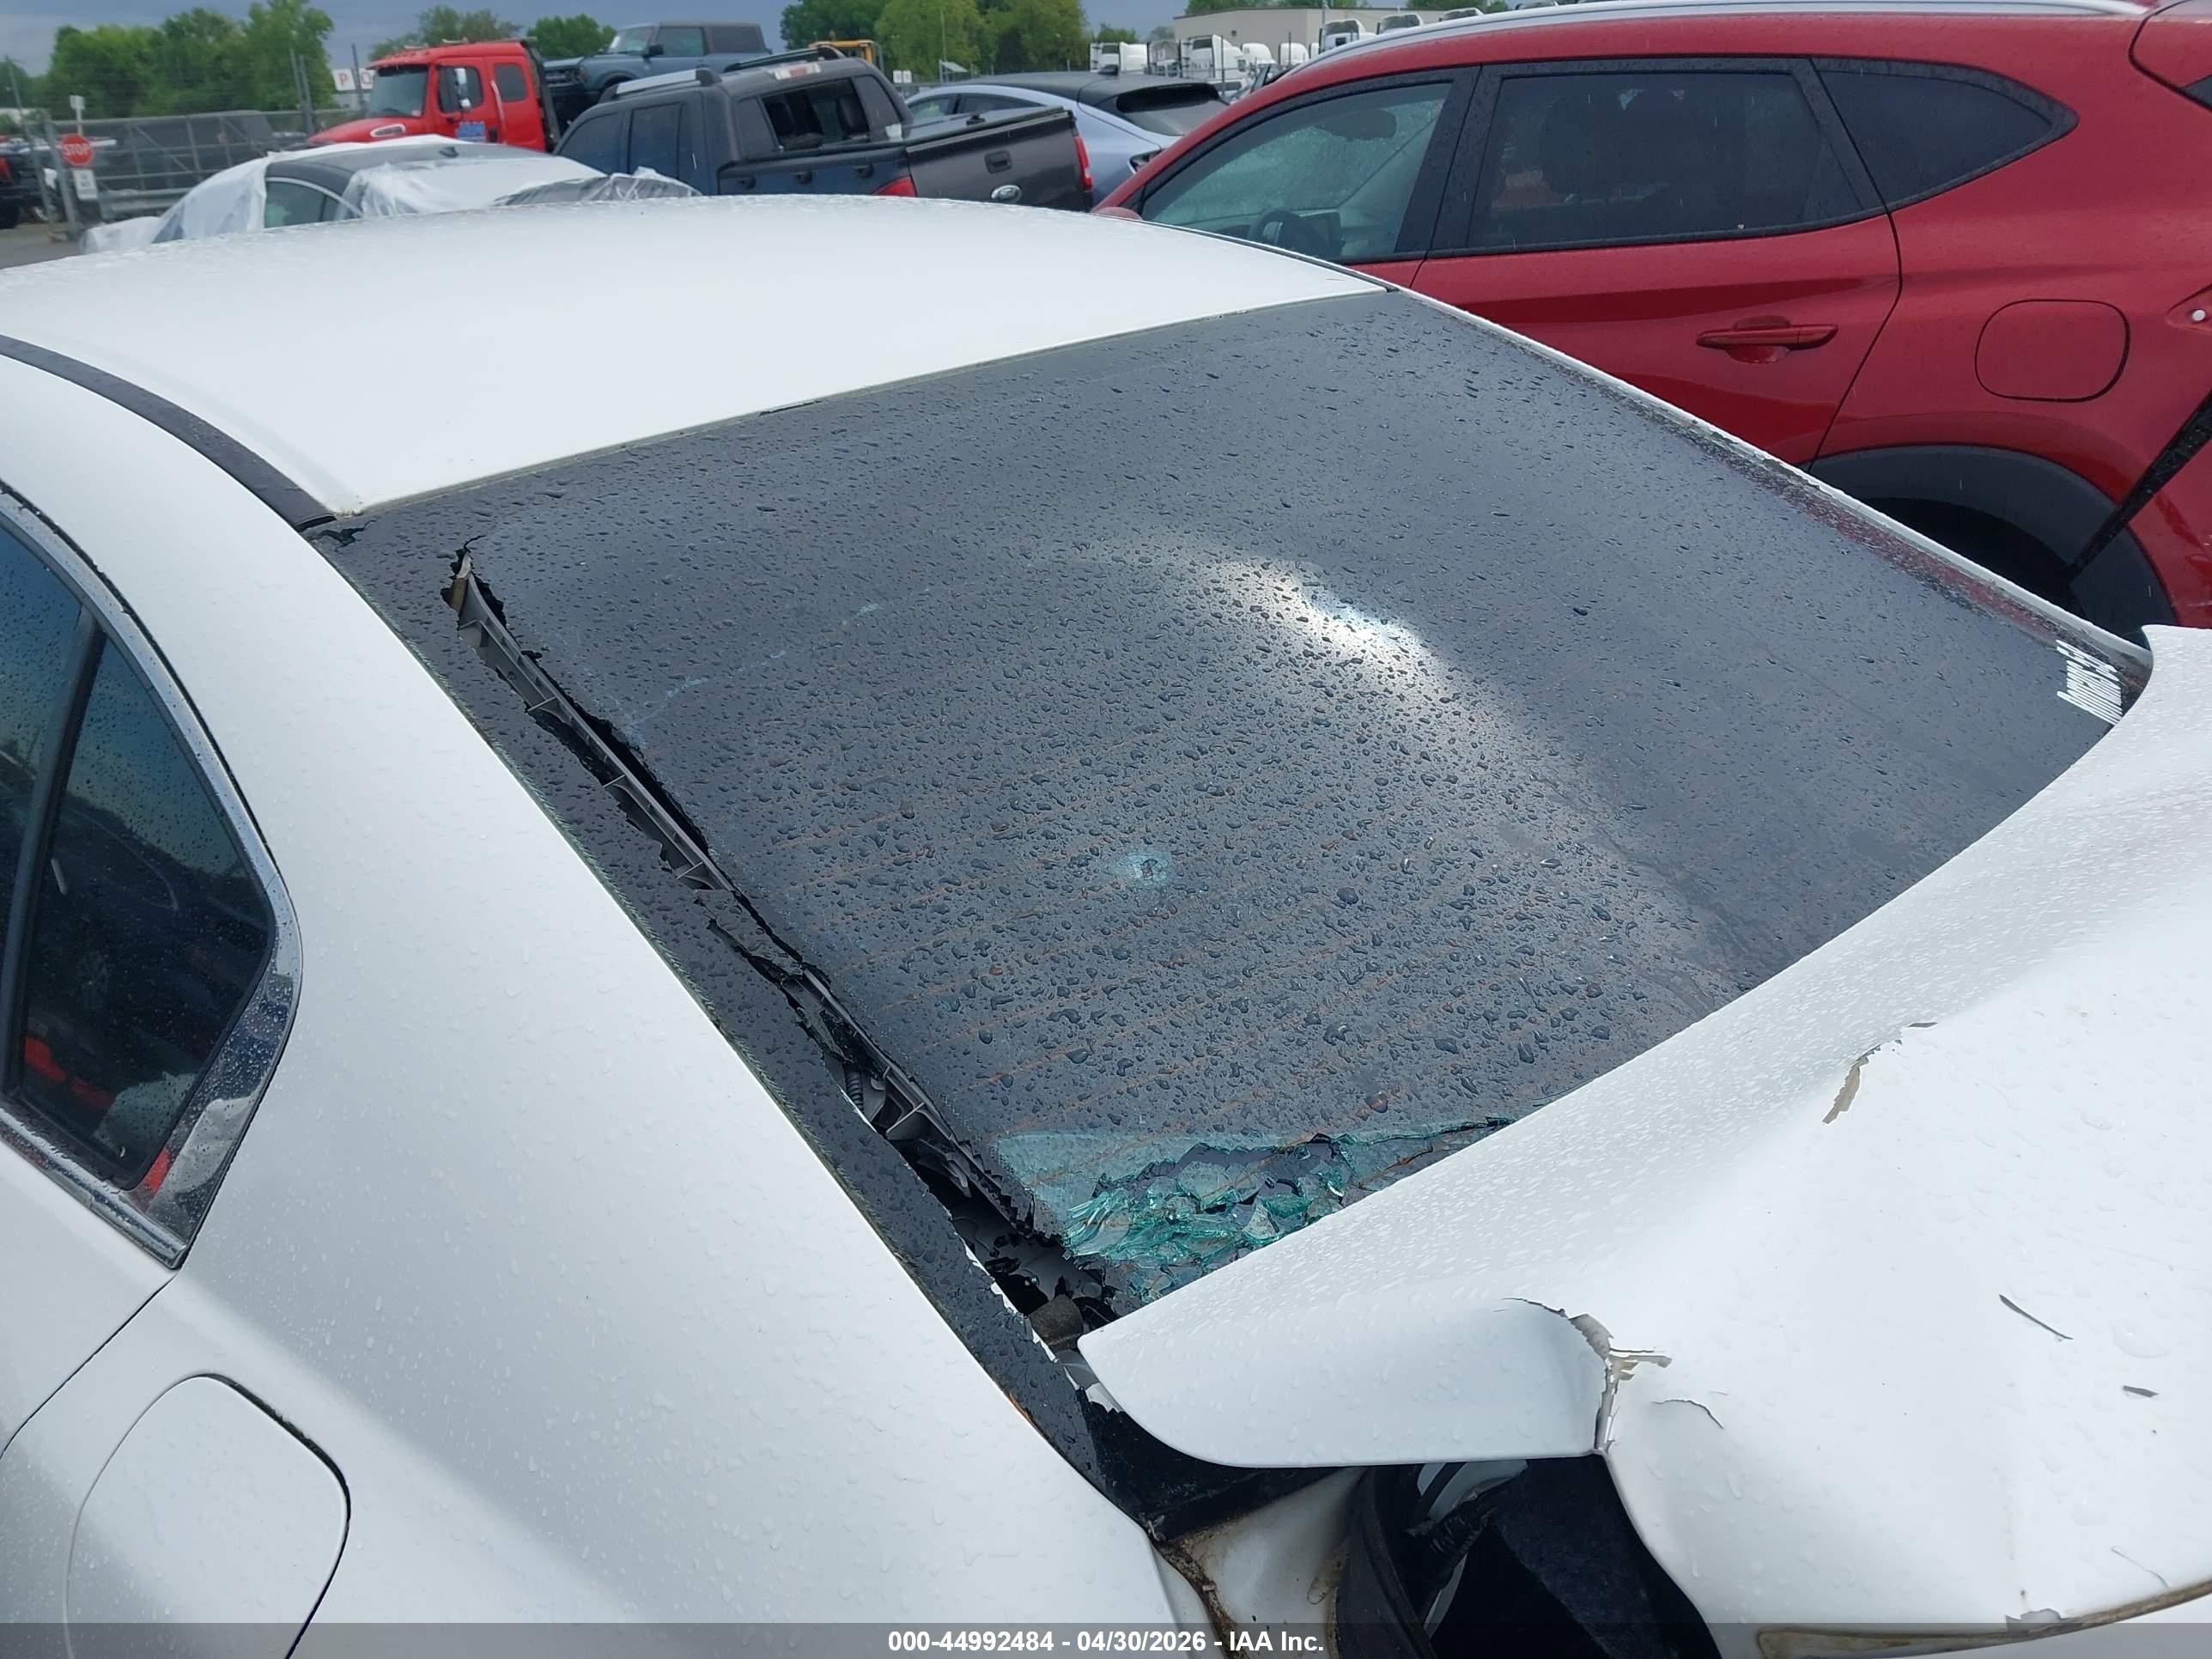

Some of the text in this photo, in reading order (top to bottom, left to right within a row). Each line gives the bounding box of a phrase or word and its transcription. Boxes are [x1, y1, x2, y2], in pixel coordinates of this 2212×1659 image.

[62, 143, 90, 156] STOP
[2055, 639, 2124, 726] Romans 5:8
